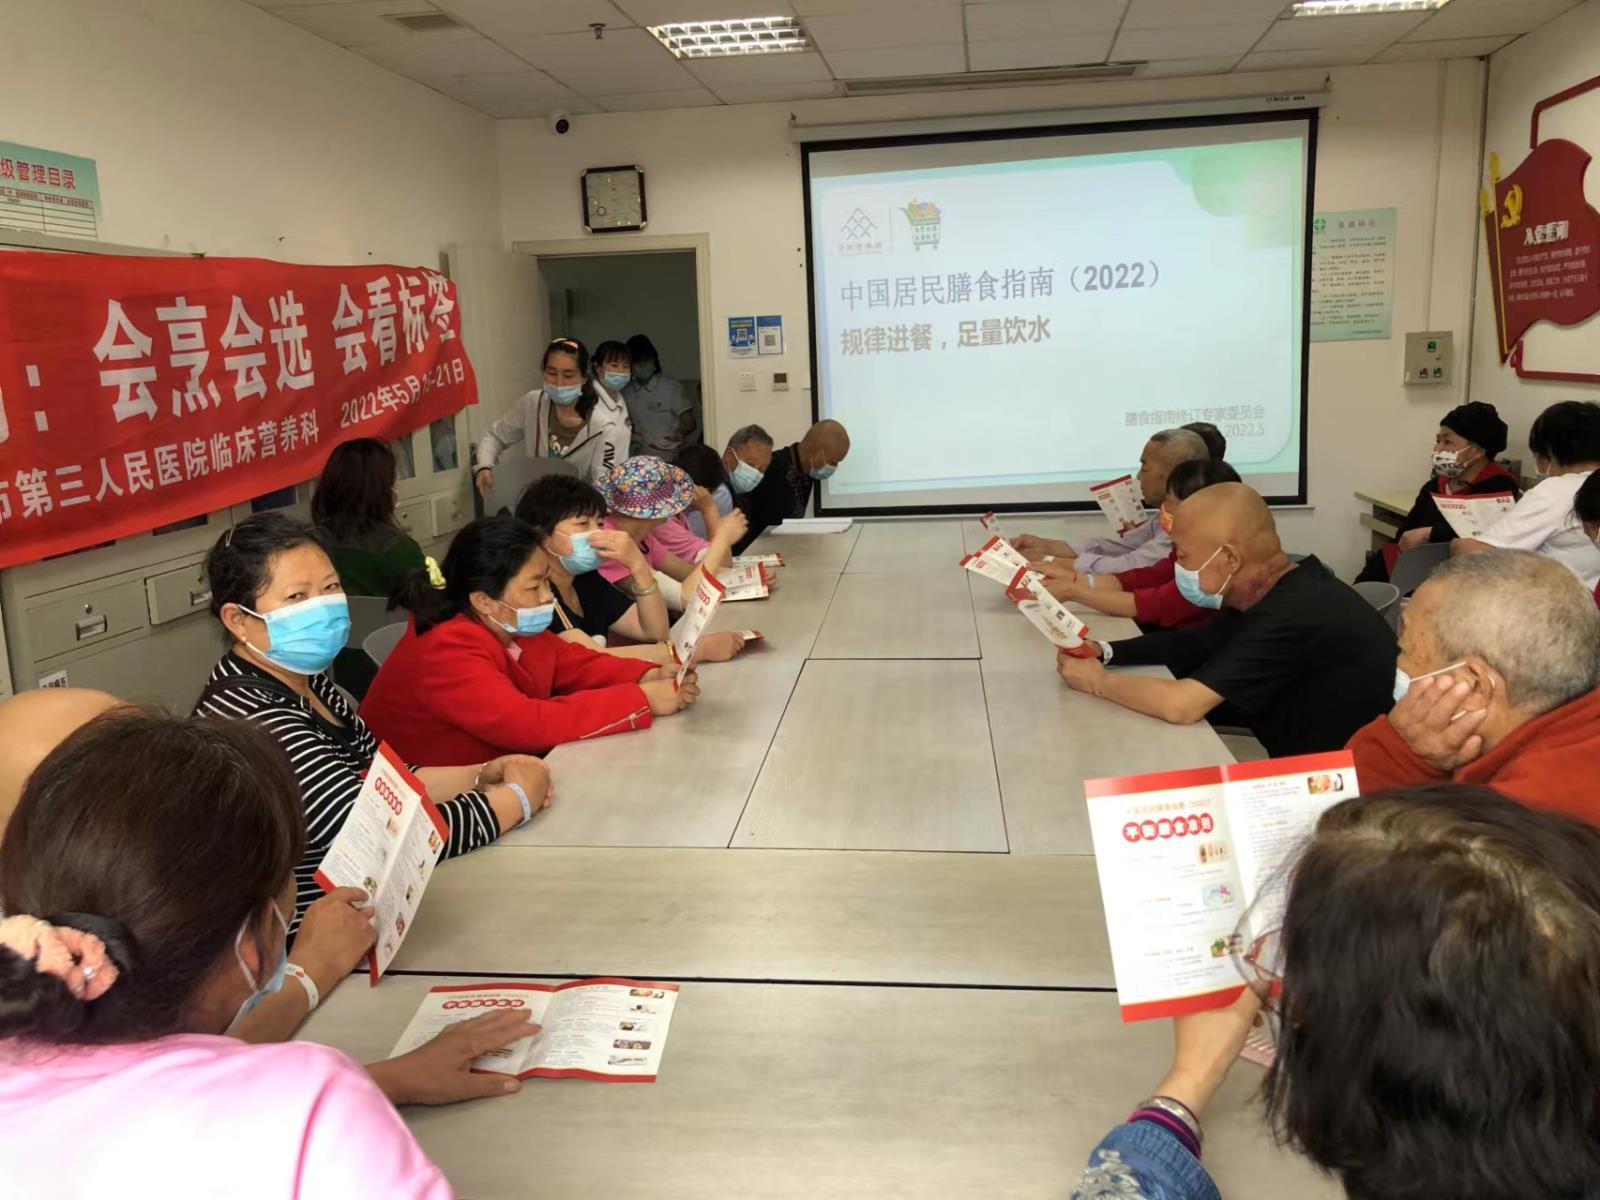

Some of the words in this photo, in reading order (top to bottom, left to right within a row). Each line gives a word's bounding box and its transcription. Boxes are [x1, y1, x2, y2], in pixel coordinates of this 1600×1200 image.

[841, 260, 1160, 311] 中国居民膳食指南（2022）
[93, 290, 315, 424] 会烹会选
[332, 270, 456, 375] 会看标签
[840, 314, 1051, 355] 规律进餐，足量饮水
